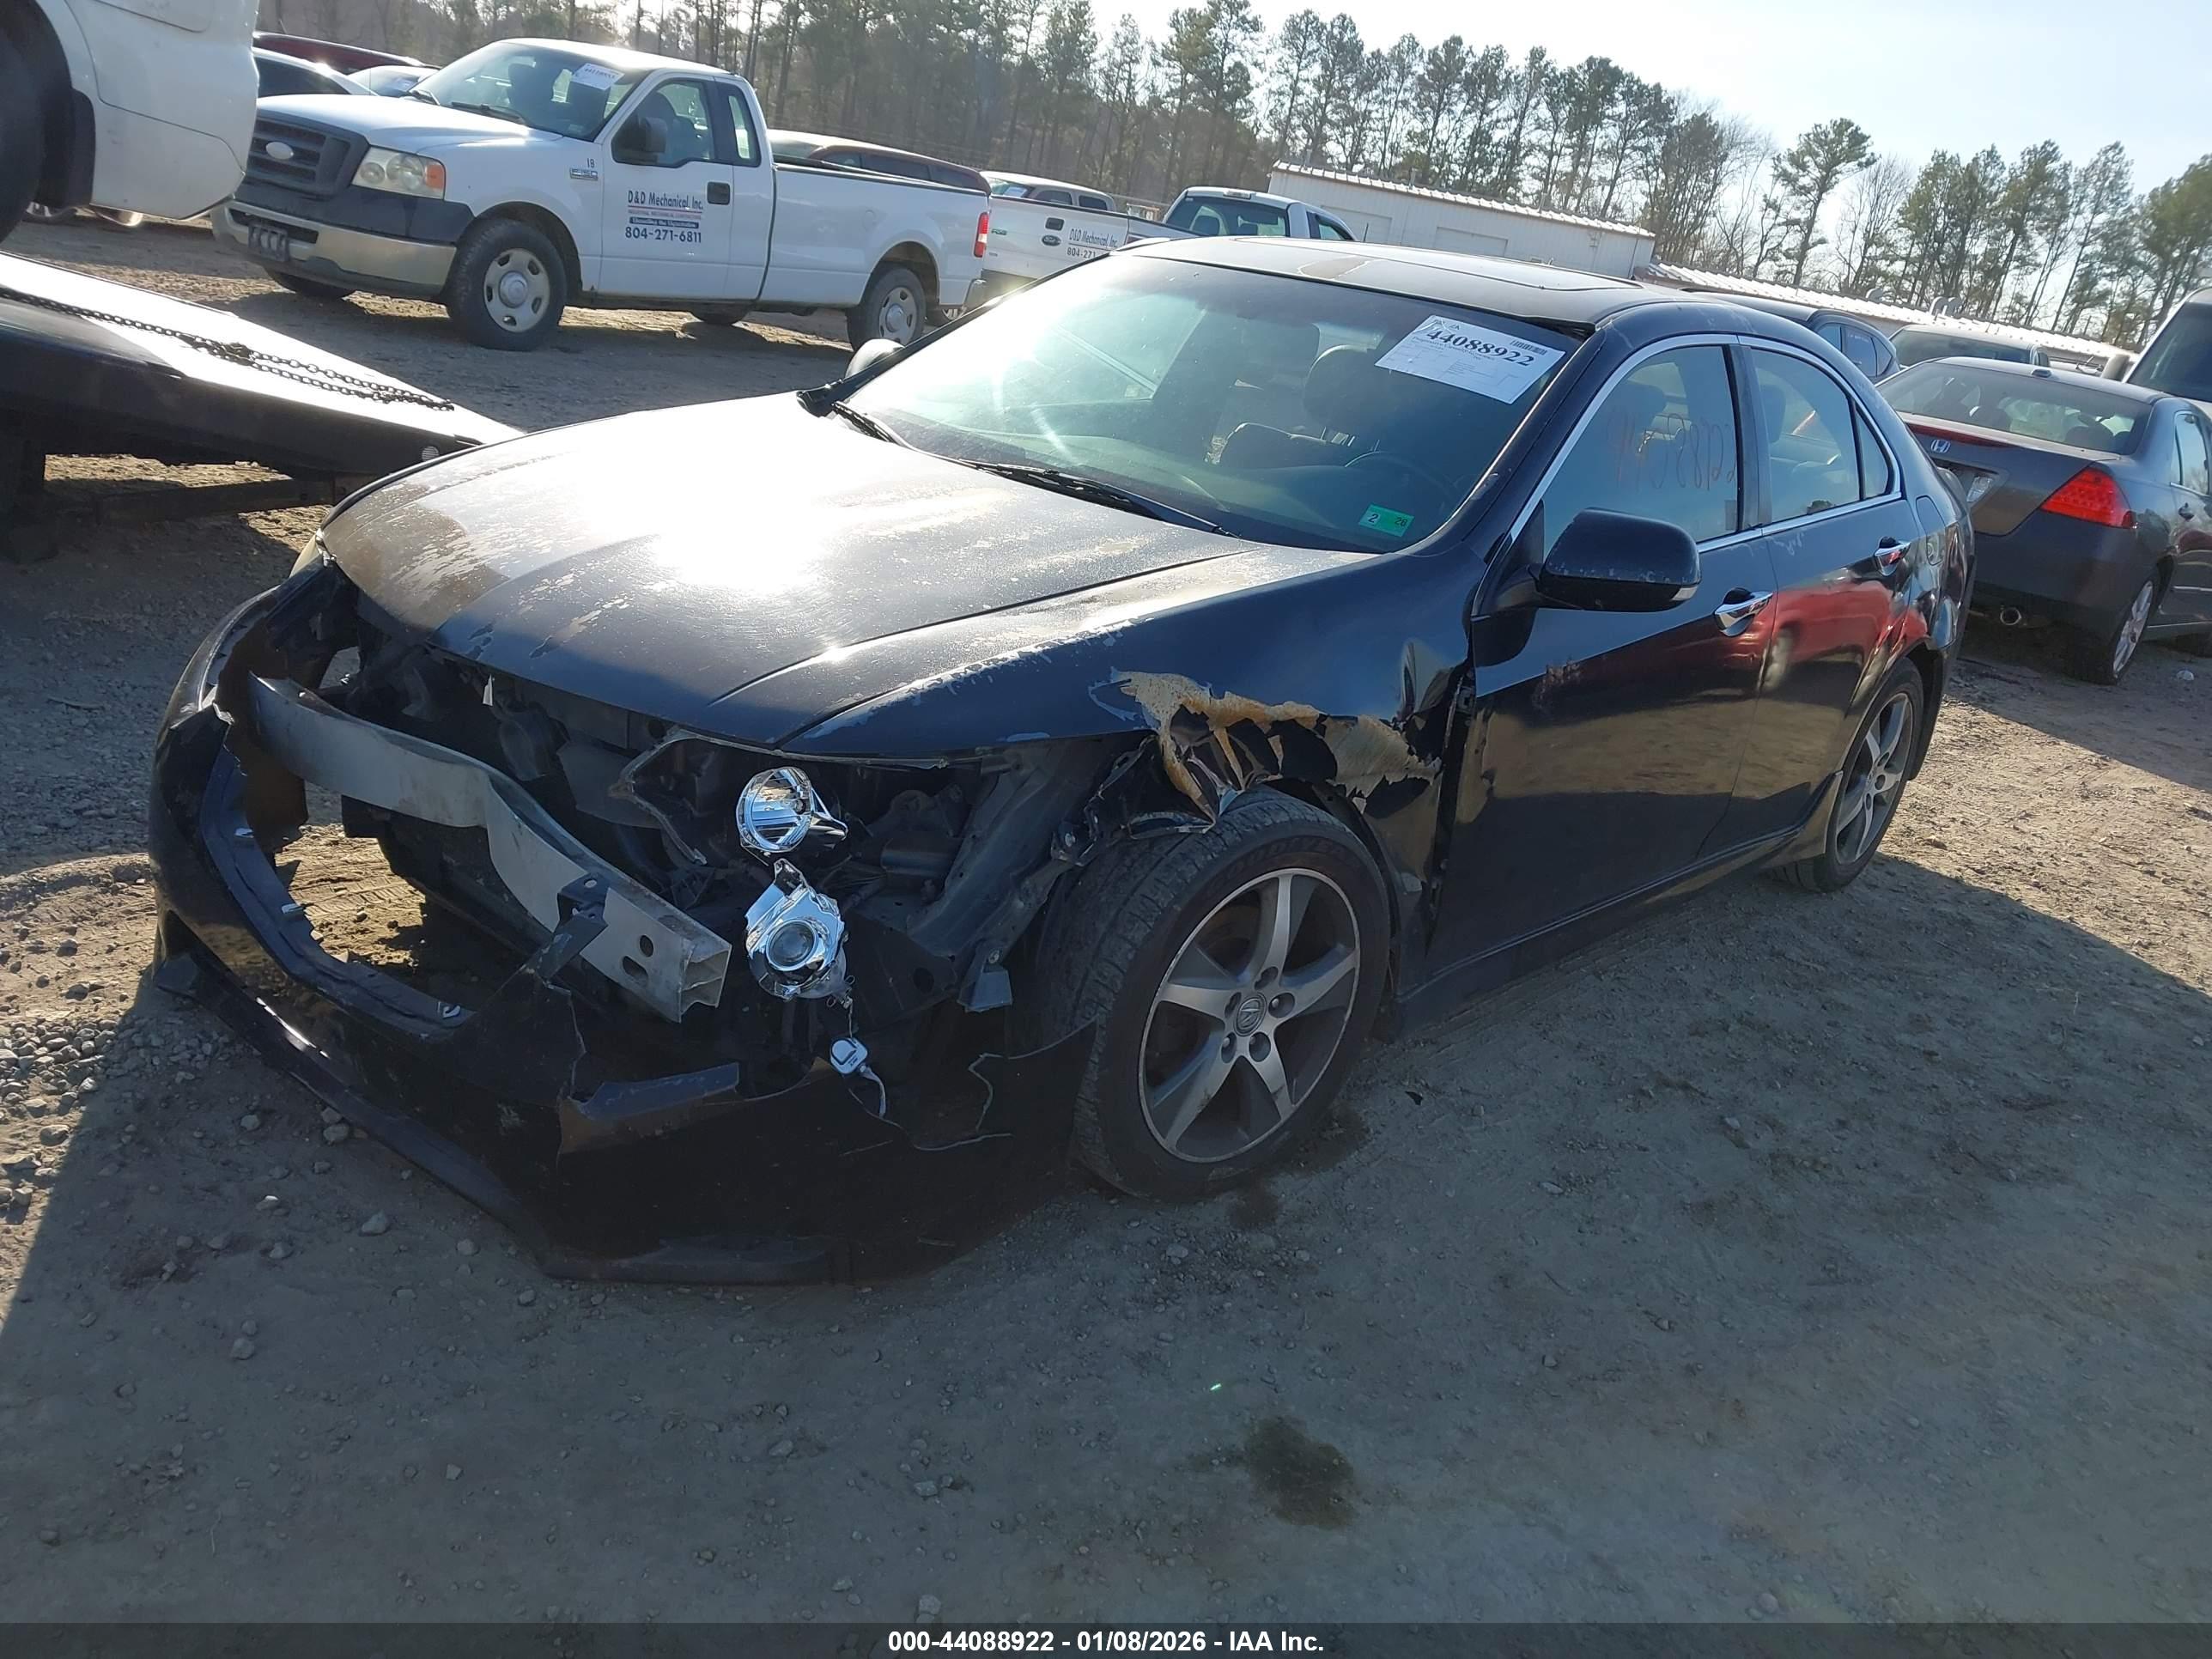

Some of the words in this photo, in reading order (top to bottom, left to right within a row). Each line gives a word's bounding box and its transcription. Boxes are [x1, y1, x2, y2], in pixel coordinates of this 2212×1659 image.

[628, 190, 646, 204] D&D
[692, 196, 703, 210] Inc.
[625, 226, 702, 243] 804-271-6811
[1425, 328, 1535, 367] 44088922
[1368, 514, 1379, 523] 2
